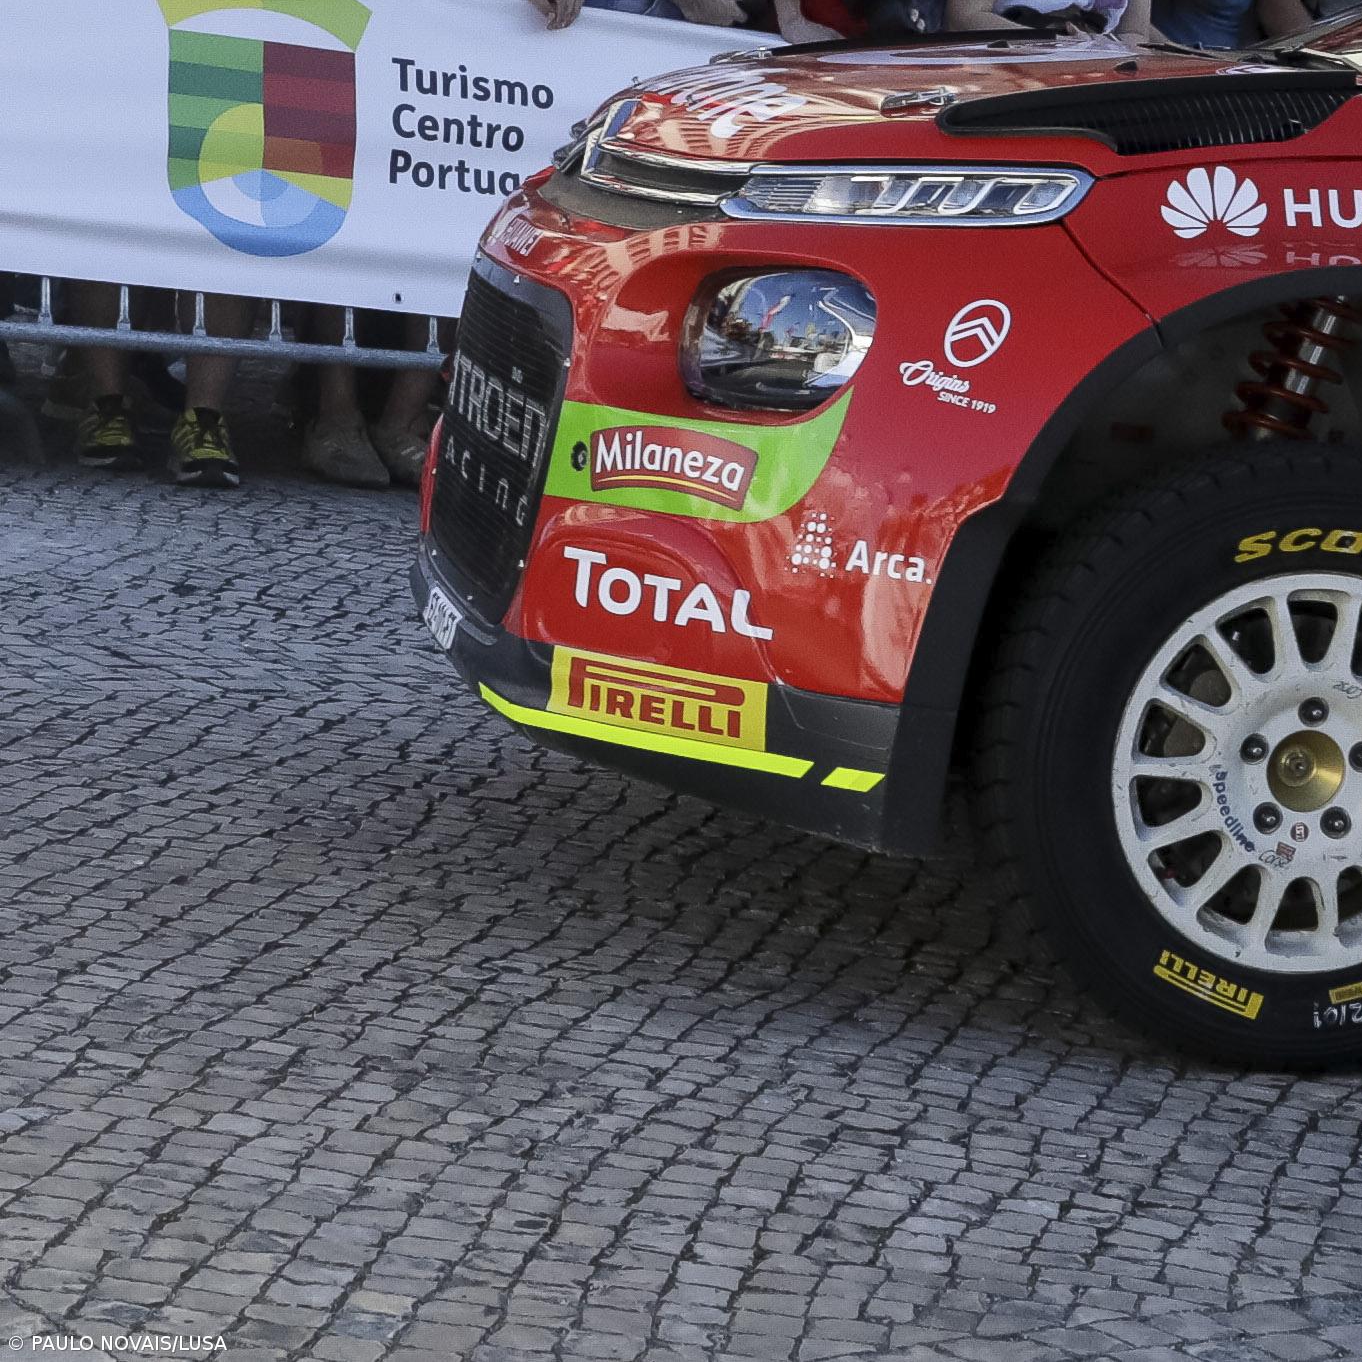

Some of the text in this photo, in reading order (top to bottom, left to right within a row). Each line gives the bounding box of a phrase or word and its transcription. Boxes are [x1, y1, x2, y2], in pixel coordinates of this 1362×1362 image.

[391, 56, 554, 109] Turismo
[391, 103, 525, 152] Centro
[389, 148, 521, 197] Portug
[900, 359, 971, 394] Origins
[937, 391, 997, 415] SINCE 1919
[594, 430, 745, 492] Milaneza
[563, 545, 774, 641] TOTAL
[567, 655, 747, 740] PIRELLI
[1212, 769, 1256, 853] speedline
[1152, 949, 1266, 1021] PIRELLI
